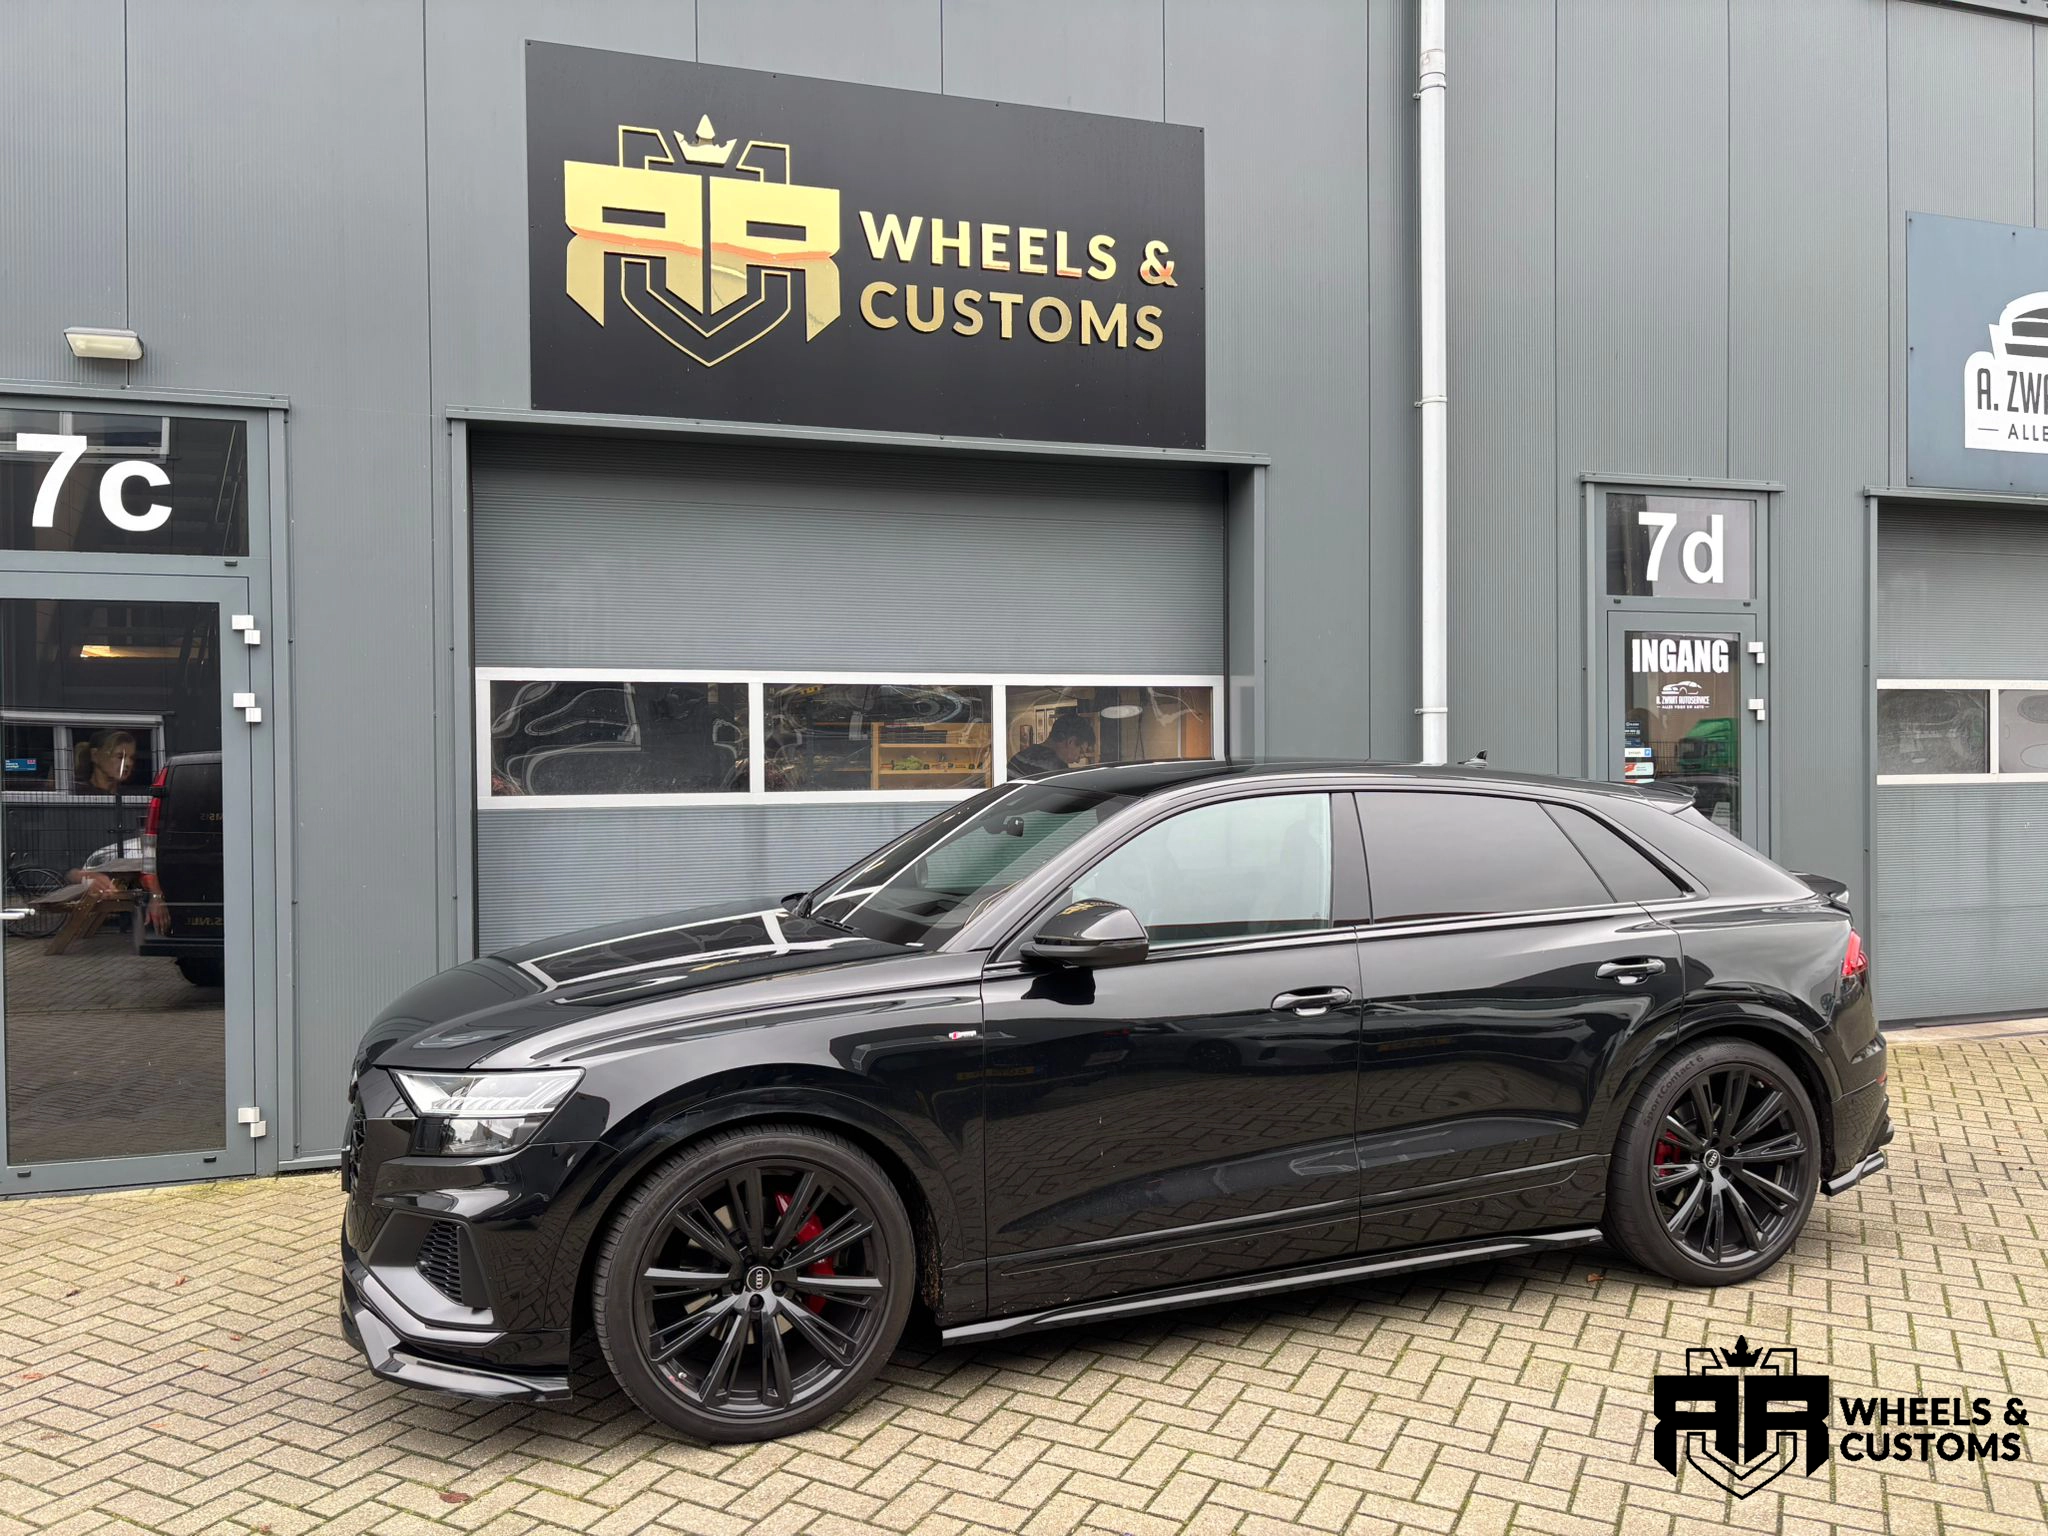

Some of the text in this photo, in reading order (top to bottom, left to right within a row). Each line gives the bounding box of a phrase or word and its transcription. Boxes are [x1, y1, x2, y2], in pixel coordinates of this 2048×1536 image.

[859, 210, 1179, 287] WHEELS &
[860, 281, 1164, 350] CUSTOMS
[1977, 368, 1999, 411] A.
[17, 433, 172, 531] 7c
[1638, 512, 1724, 583] 7d
[1632, 639, 1729, 673] INGANG
